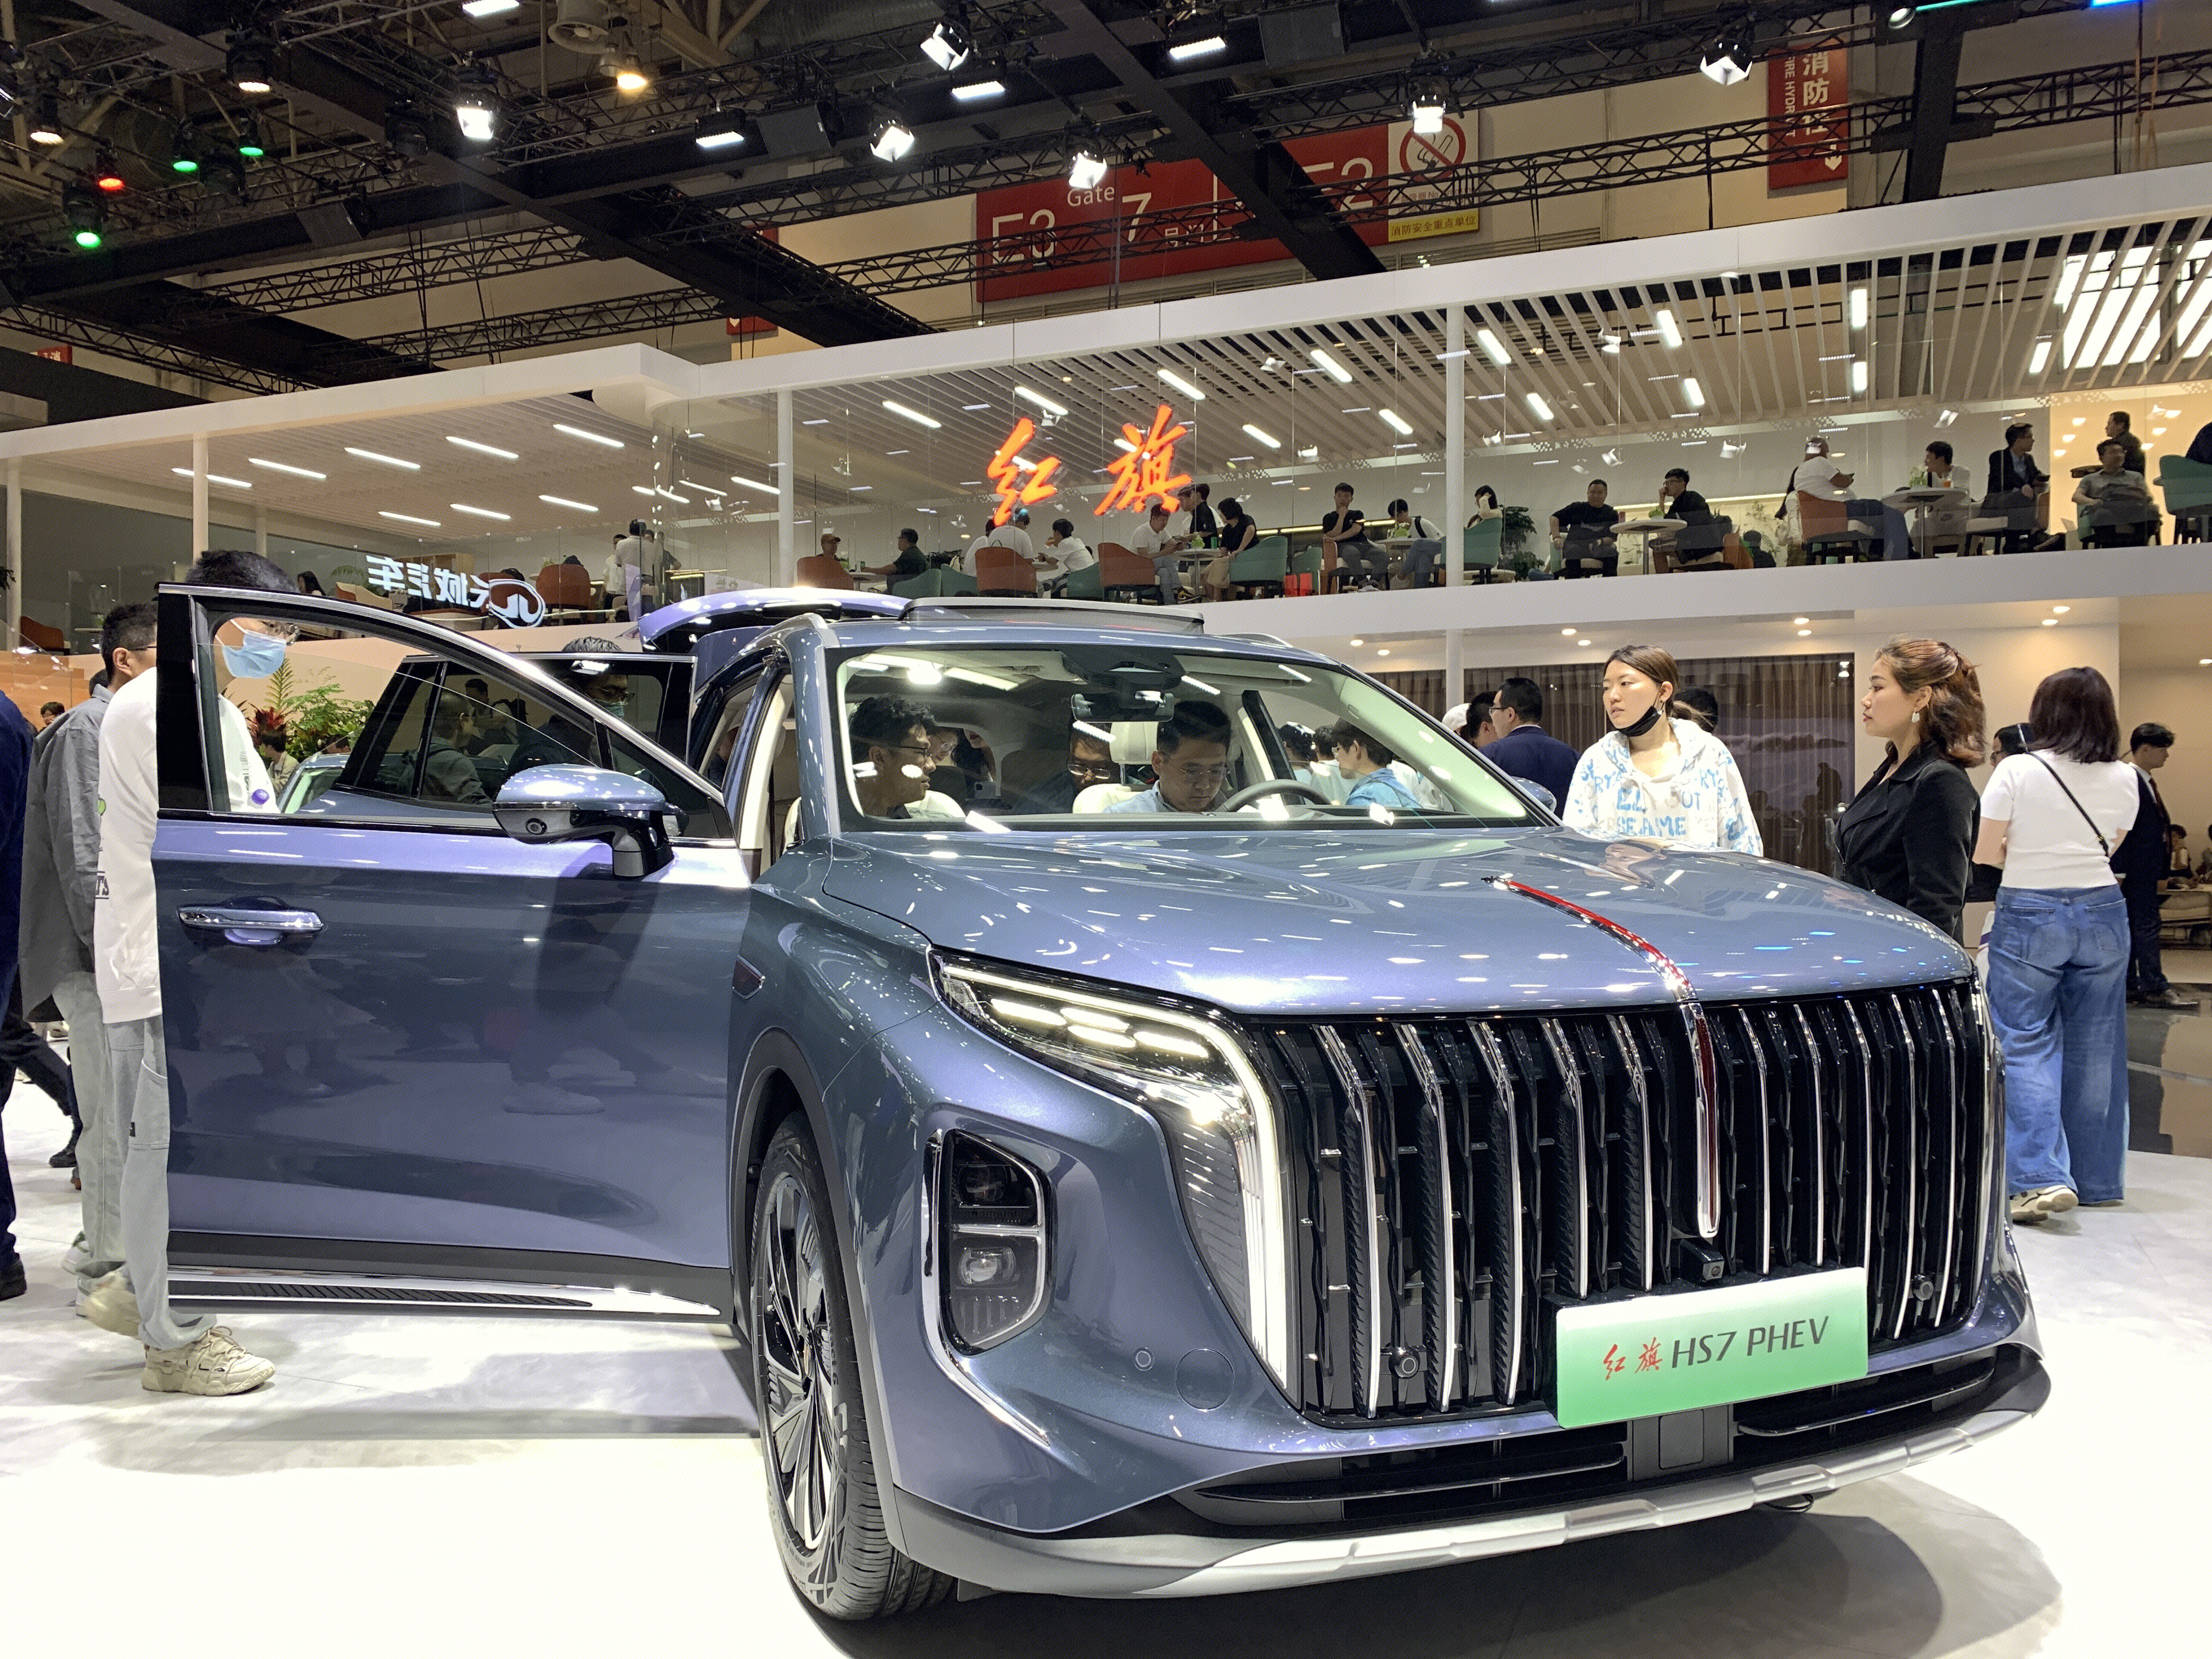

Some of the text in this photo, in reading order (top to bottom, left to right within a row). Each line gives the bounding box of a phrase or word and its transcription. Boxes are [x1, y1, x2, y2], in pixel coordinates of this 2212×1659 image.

[1066, 186, 1115, 207] Gate
[1122, 193, 1152, 242] 7
[992, 209, 1057, 264] E3
[1391, 215, 1476, 236] 消防安全重点单位
[987, 404, 1193, 527] 红旗
[1603, 1316, 1829, 1381] 红旗 HS7 PHEV
